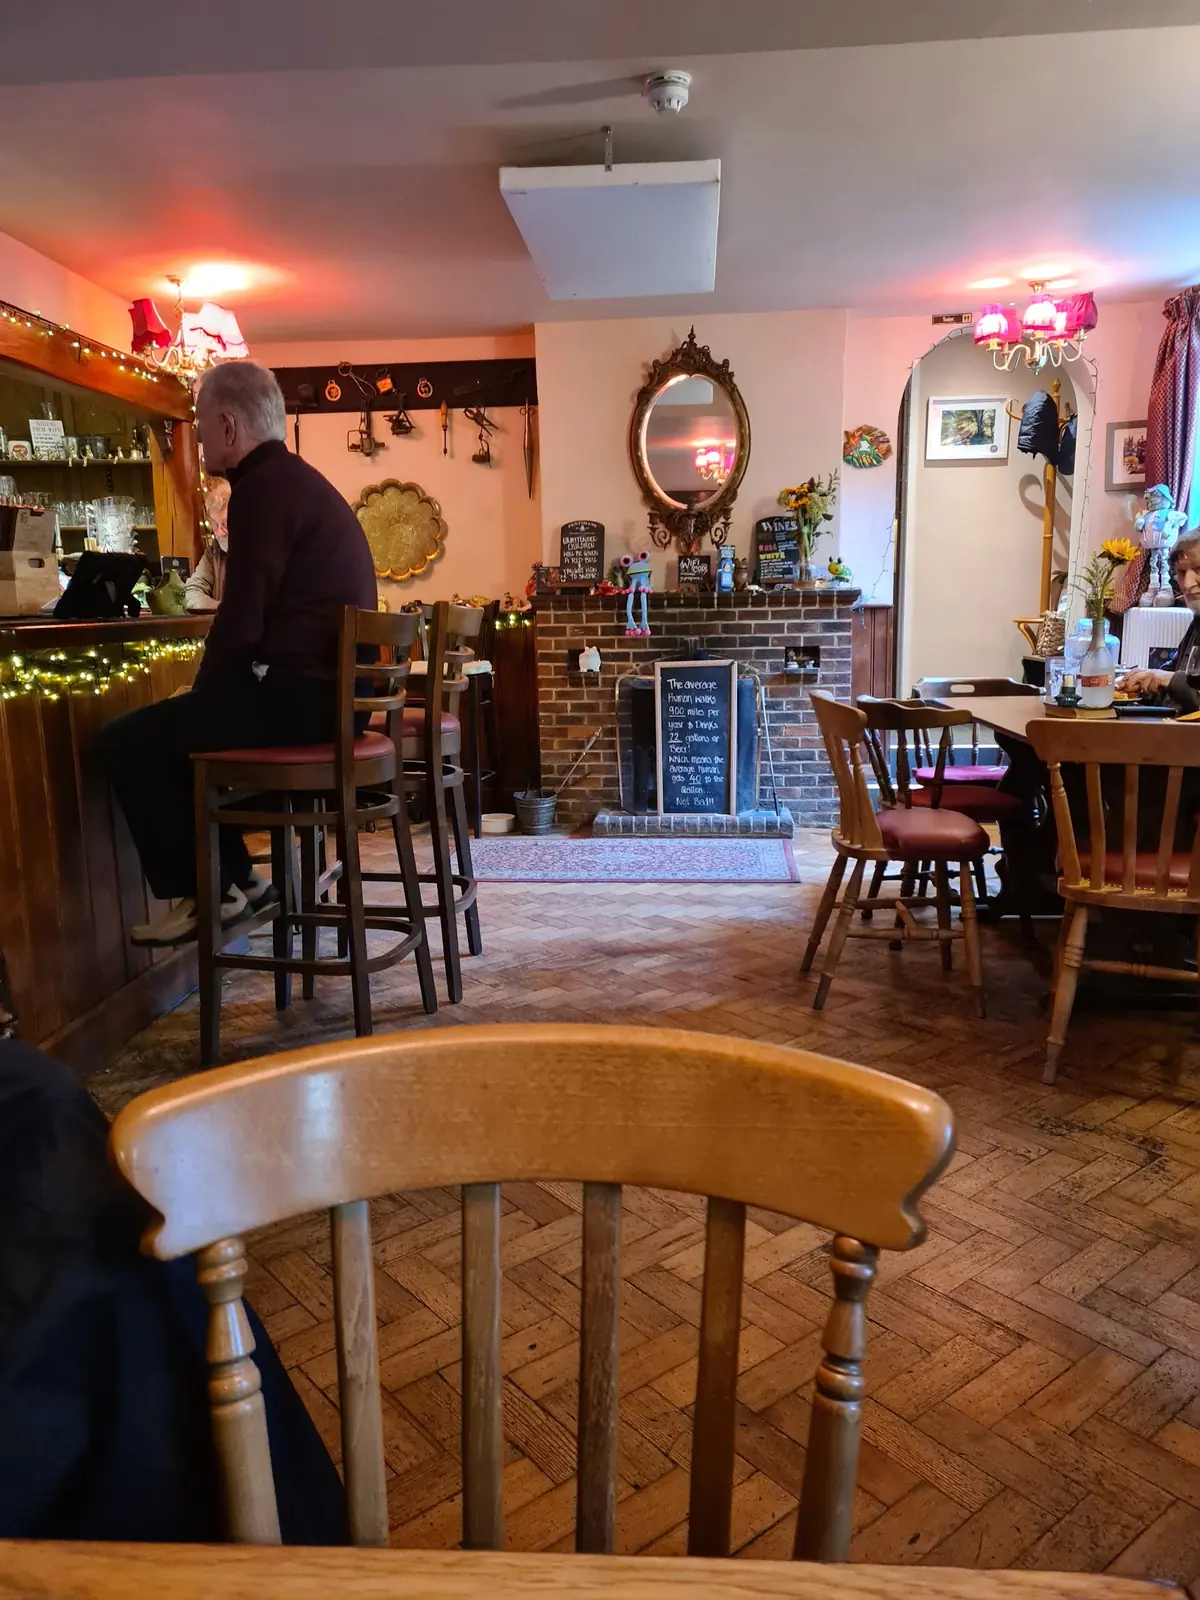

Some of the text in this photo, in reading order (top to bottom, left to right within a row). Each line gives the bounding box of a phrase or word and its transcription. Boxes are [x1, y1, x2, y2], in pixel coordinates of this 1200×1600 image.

[761, 519, 798, 532] WINES
[760, 552, 785, 560] WHITE
[666, 678, 718, 692] The average
[668, 692, 716, 704] Human walks
[669, 705, 720, 718] 900 miles per
[668, 721, 684, 731] year
[669, 732, 679, 741] 22
[685, 733, 709, 744] gallons
[691, 756, 712, 764] means
[714, 756, 725, 764] the
[669, 765, 695, 774] average
[688, 774, 702, 783] 40
[676, 796, 690, 806] Not
